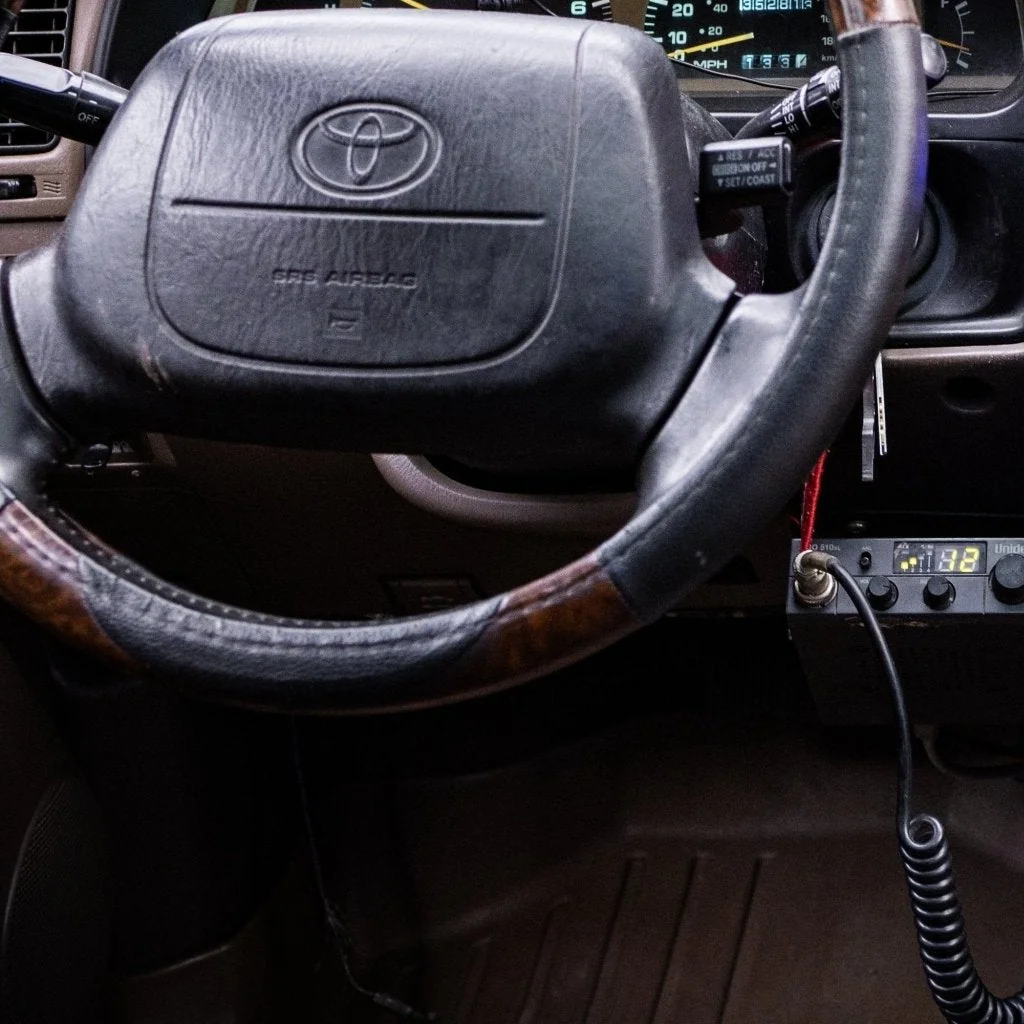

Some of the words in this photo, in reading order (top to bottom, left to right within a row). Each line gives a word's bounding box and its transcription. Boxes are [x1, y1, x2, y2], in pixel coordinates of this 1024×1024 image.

[570, 0, 587, 16] 6
[672, 3, 694, 18] 20
[713, 3, 728, 13] 40
[668, 30, 687, 45] 10
[707, 26, 723, 36] 20
[693, 59, 728, 70] MPH
[78, 111, 100, 125] OFF
[784, 112, 795, 125] LO
